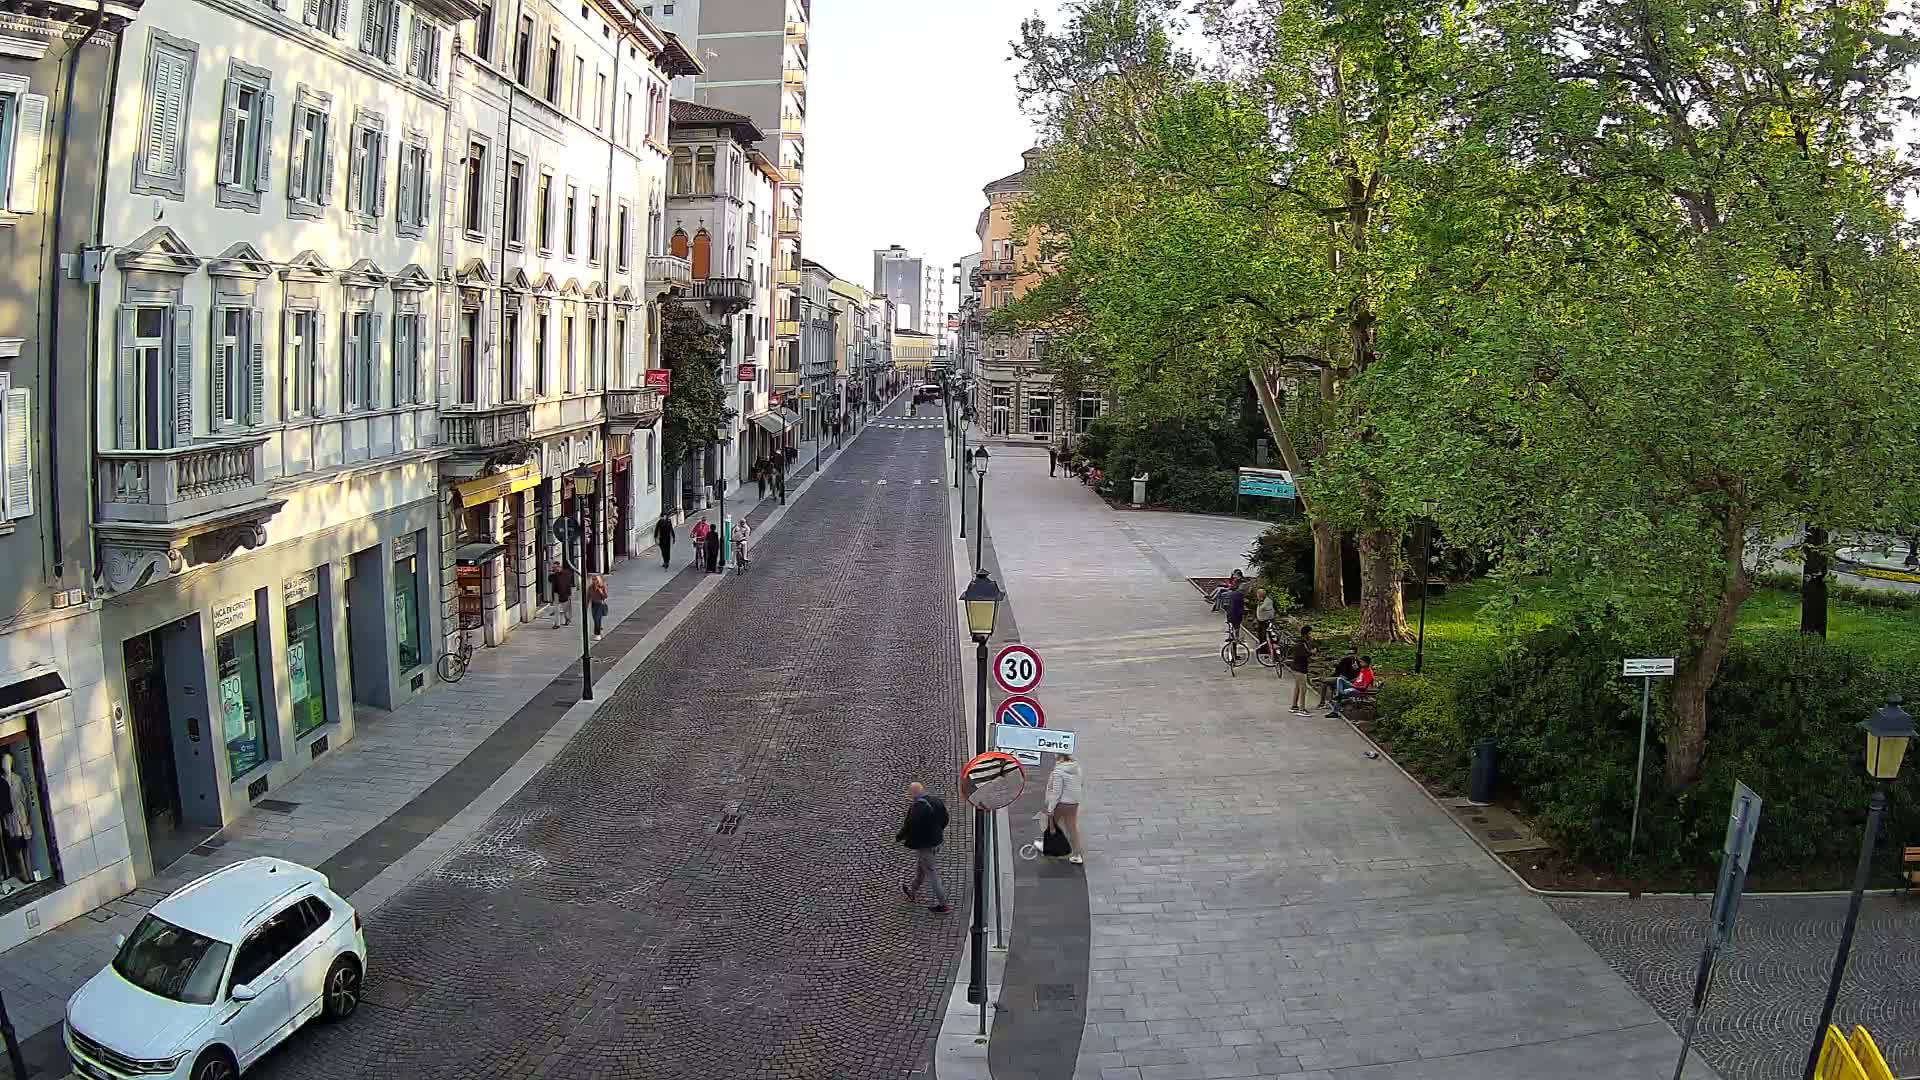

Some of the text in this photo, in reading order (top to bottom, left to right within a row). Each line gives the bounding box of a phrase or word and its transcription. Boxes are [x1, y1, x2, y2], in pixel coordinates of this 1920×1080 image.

[1005, 658, 1033, 681] 30
[221, 677, 240, 701] 130
[1038, 738, 1069, 750] Dante
